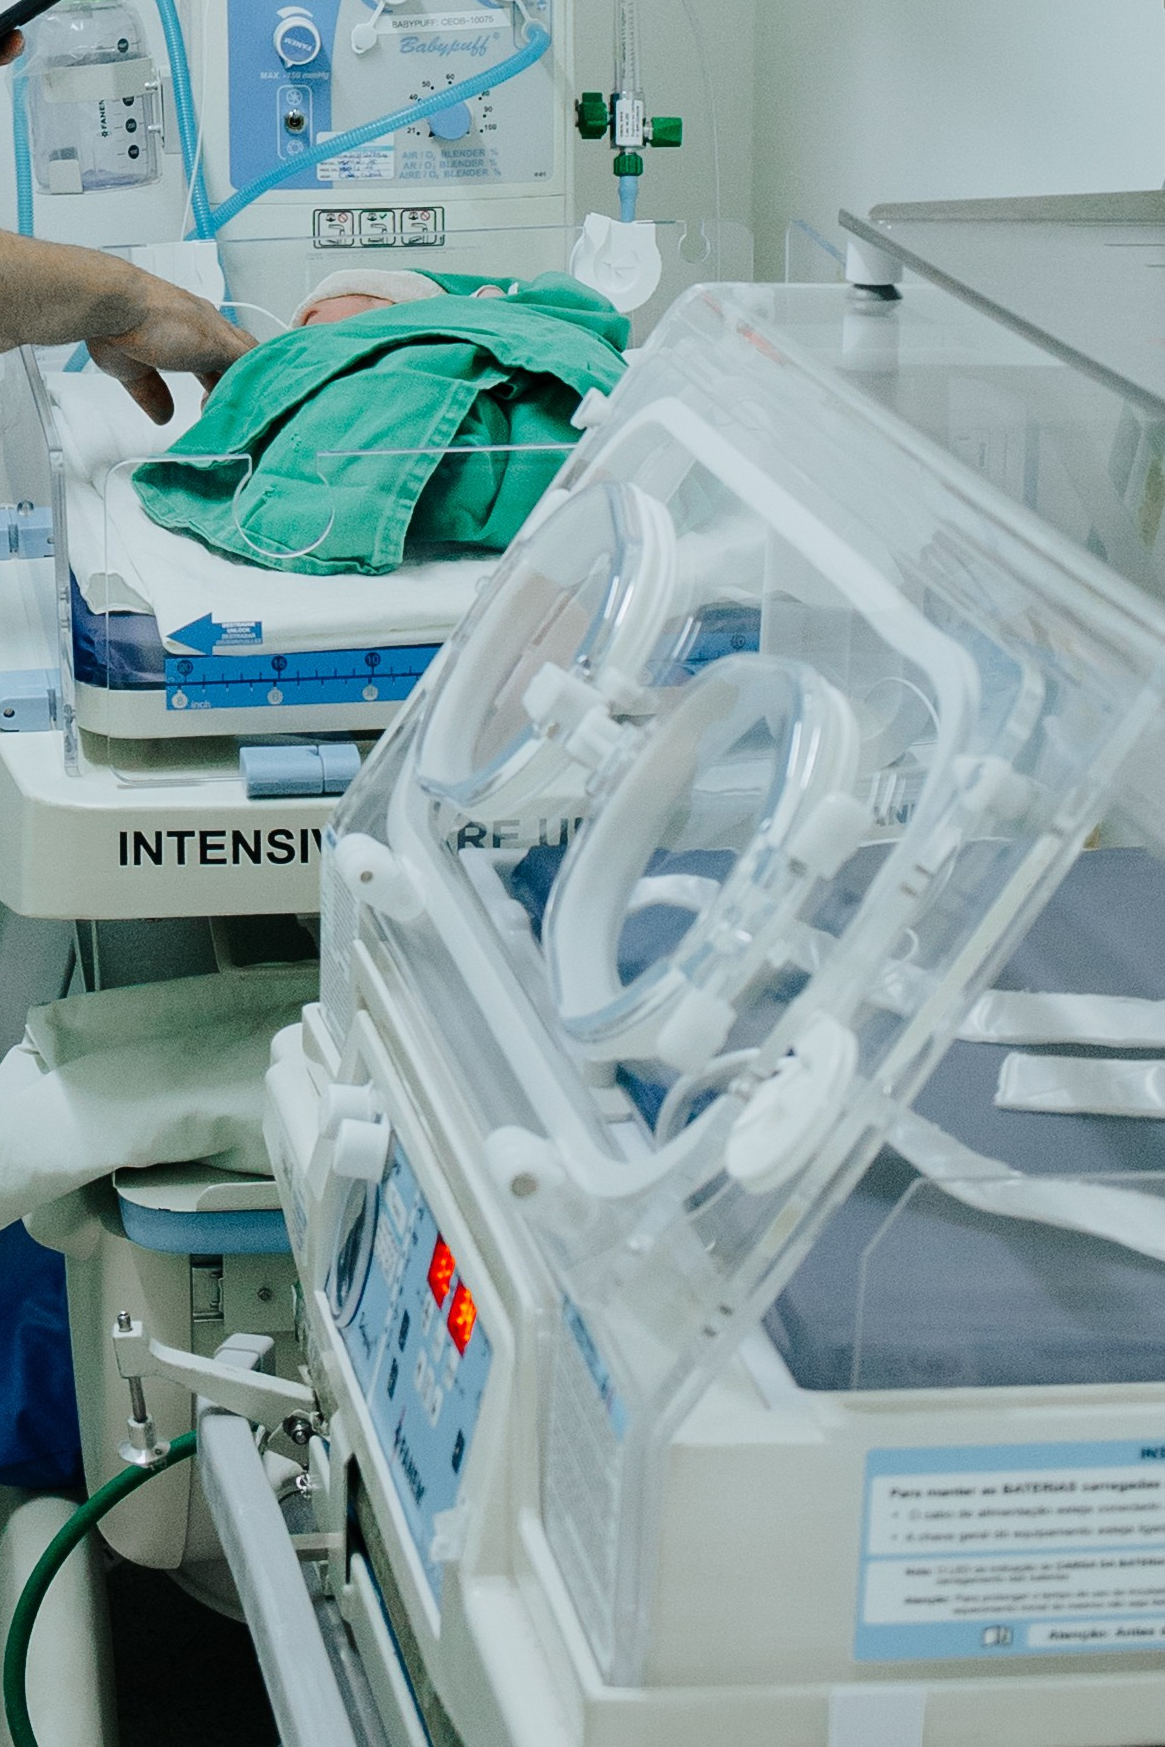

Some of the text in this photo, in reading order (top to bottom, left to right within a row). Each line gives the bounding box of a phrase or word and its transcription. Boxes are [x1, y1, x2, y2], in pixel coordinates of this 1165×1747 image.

[274, 659, 285, 668] 15
[367, 655, 379, 664] 10
[190, 700, 212, 709] inch
